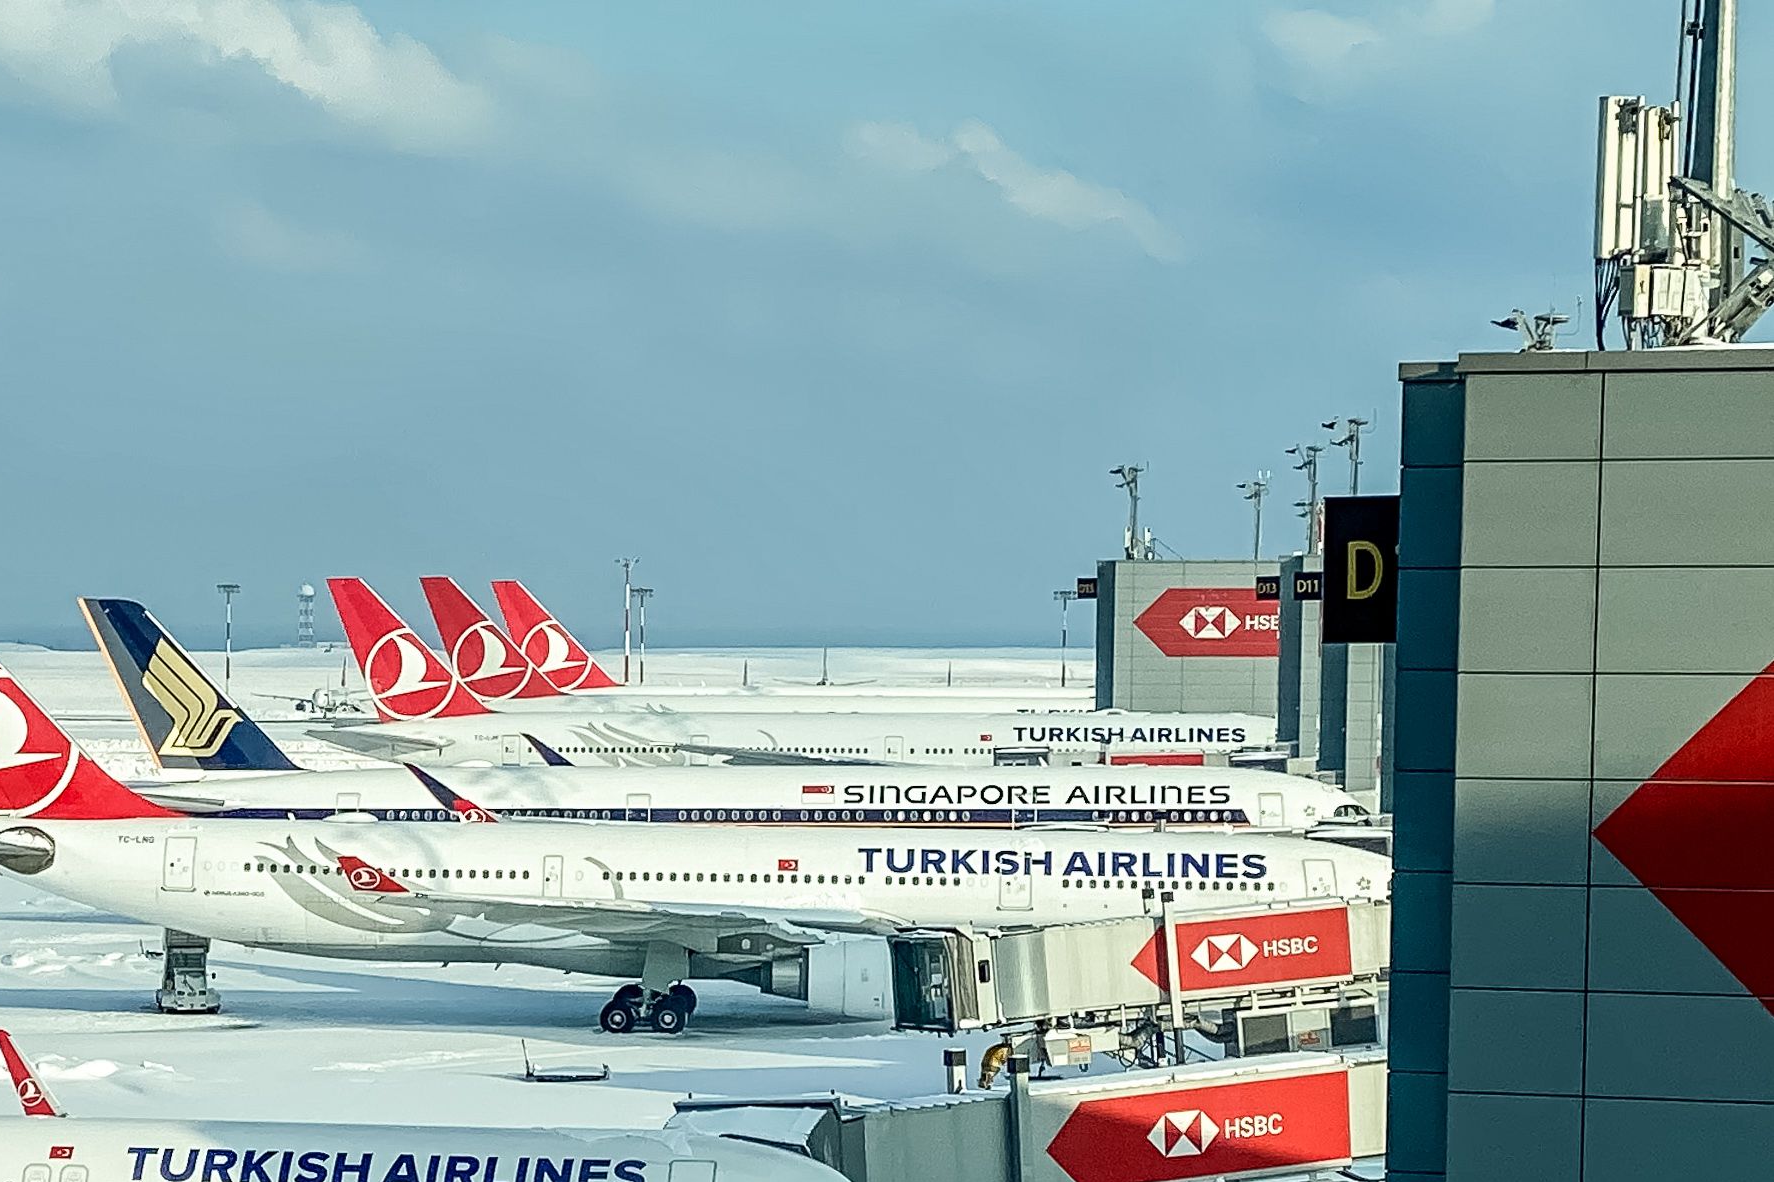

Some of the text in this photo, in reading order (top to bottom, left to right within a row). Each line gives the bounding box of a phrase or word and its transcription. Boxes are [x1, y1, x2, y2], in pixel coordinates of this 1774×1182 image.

[1346, 540, 1383, 600] D
[1257, 582, 1277, 594] D13
[1296, 579, 1319, 593] D11
[1013, 727, 1246, 743] TURKISH AIRLINES
[843, 784, 1231, 806] SINGAPORE AIRLINES
[858, 847, 1268, 880] TURKISH AIRLINES
[1262, 935, 1319, 958] HSBC
[1224, 1113, 1284, 1139] HSBC
